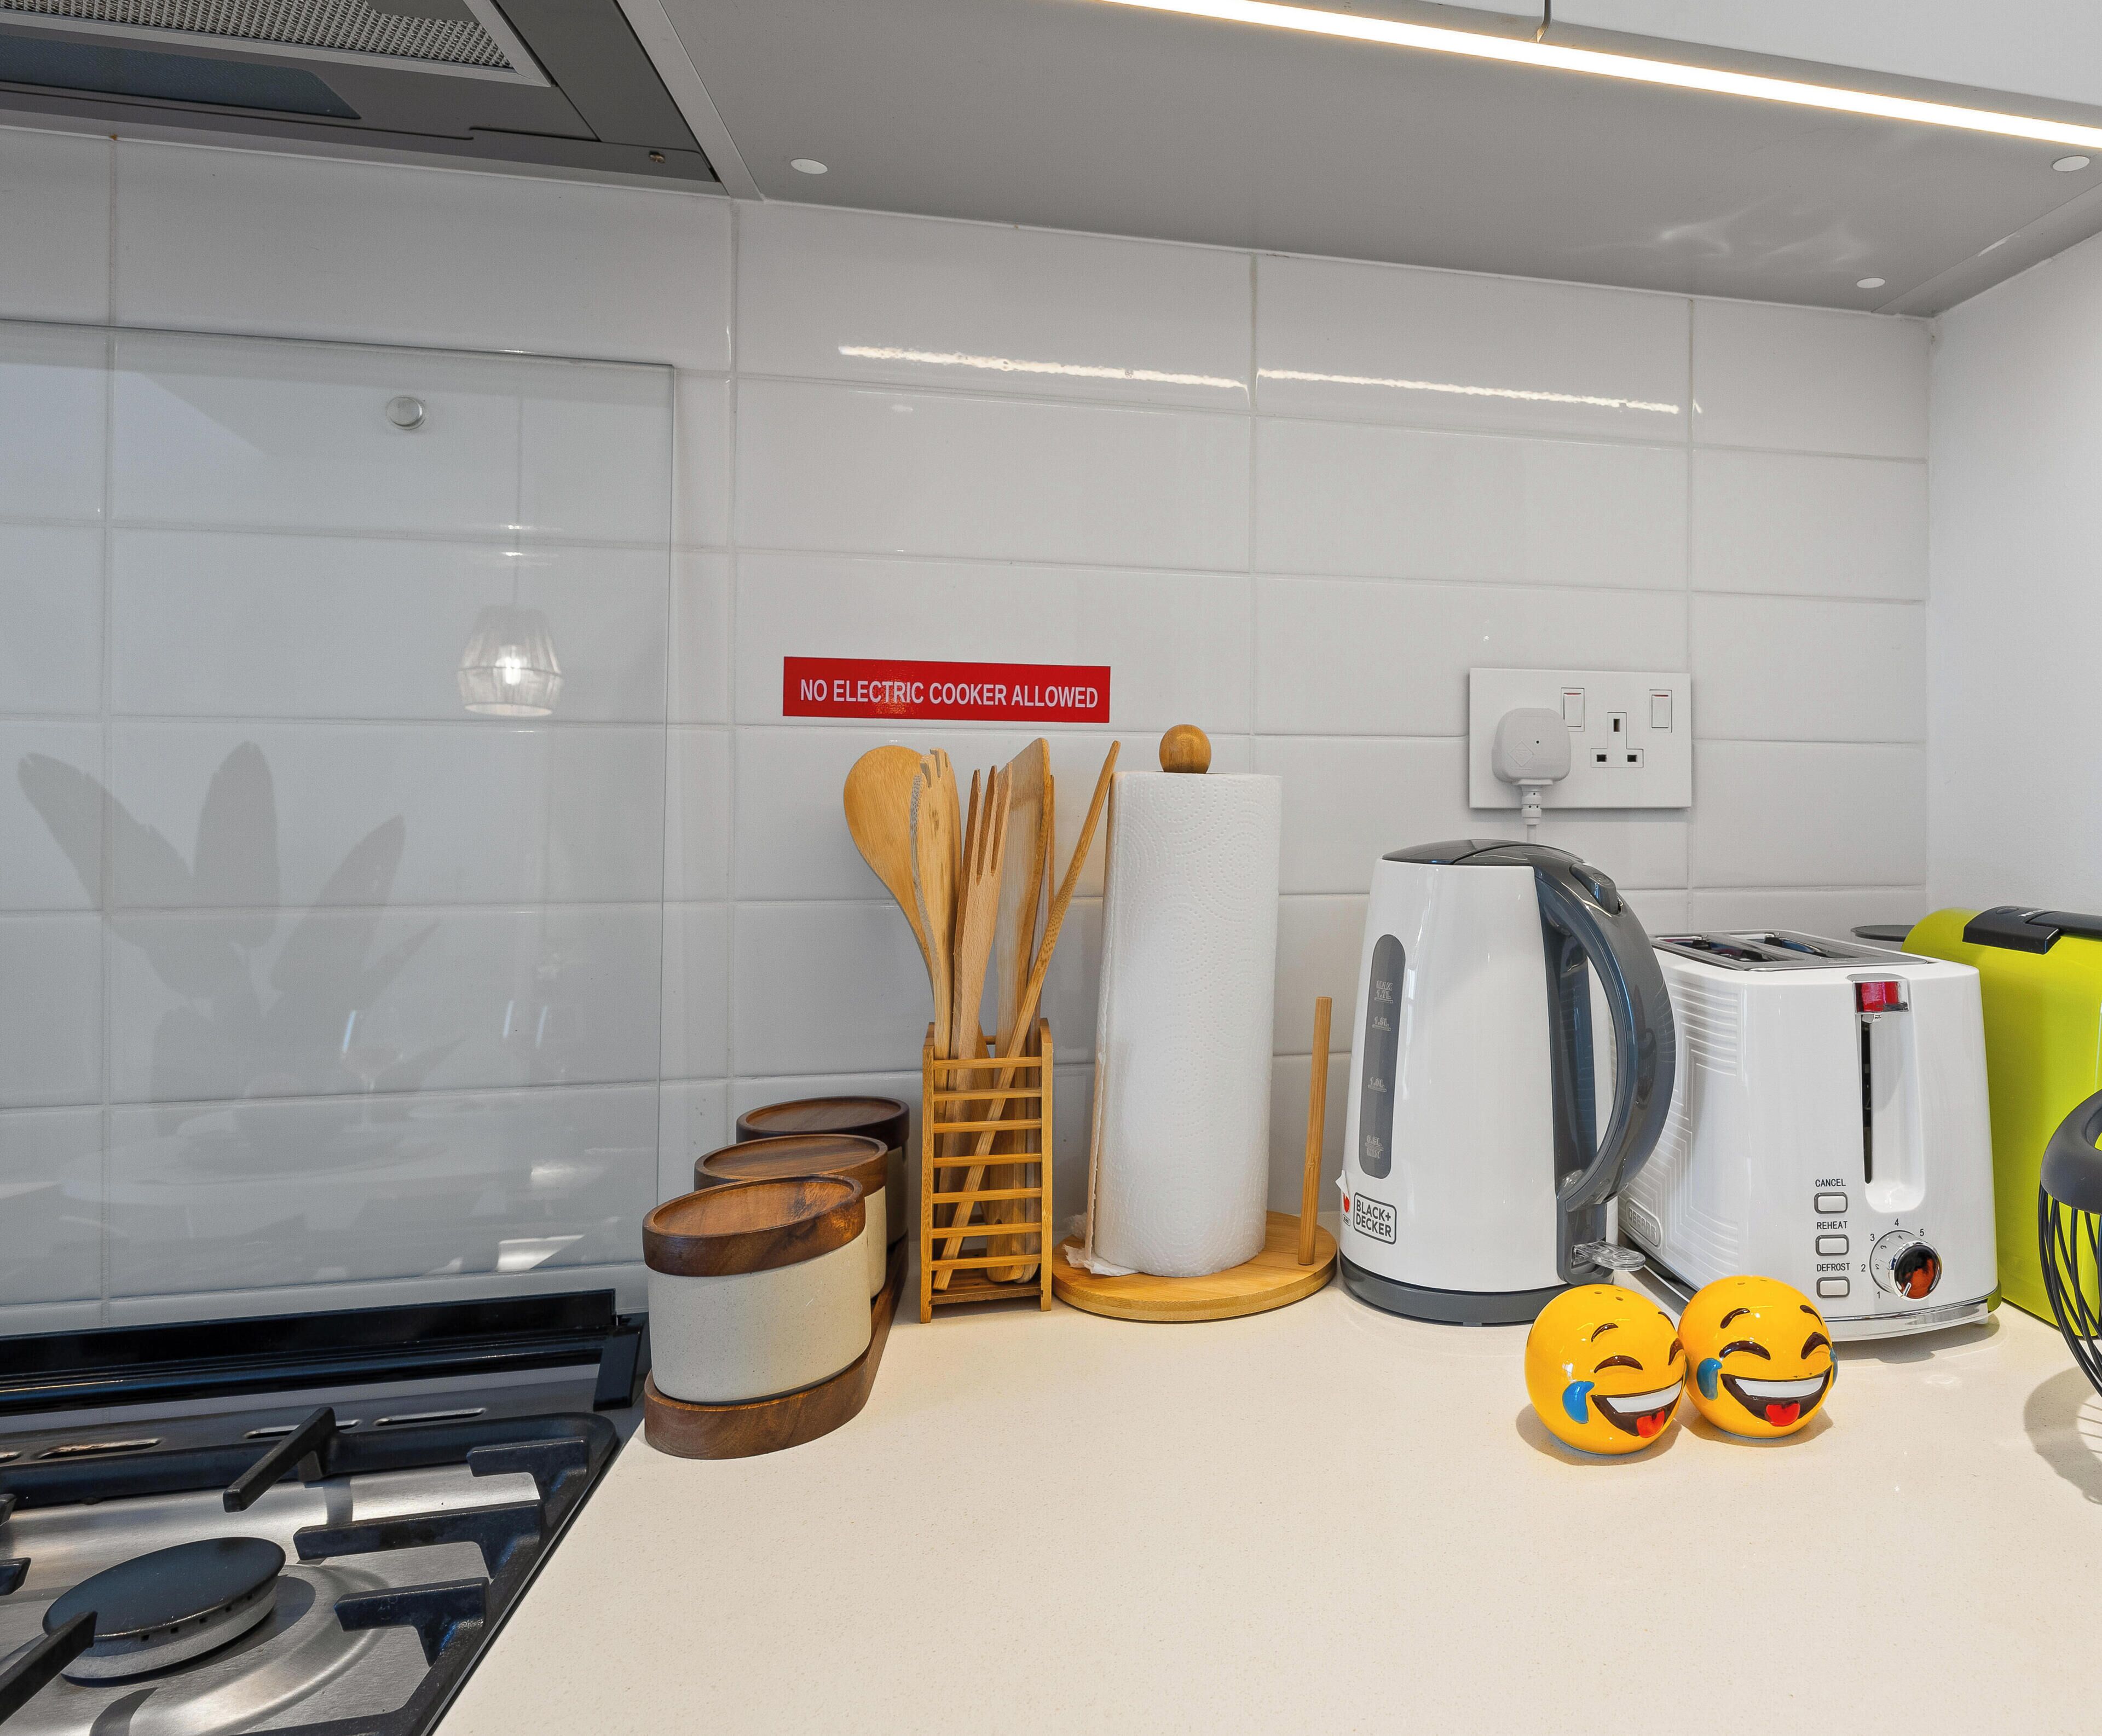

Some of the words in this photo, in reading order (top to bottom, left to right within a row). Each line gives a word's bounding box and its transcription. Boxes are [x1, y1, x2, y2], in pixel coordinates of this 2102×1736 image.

[800, 679, 827, 701] NO
[833, 680, 924, 704] ELECTRIC
[929, 682, 1007, 705] COOKER
[1011, 685, 1098, 708] ALLOWED
[1815, 1179, 1846, 1187] CANCEL
[1356, 1198, 1391, 1222] BLACK+
[1356, 1212, 1391, 1238] DECKER
[1817, 1221, 1848, 1230] REHEAT
[1894, 1218, 1899, 1226] 4
[1870, 1233, 1875, 1242] 3
[1920, 1229, 1925, 1237] 5
[1816, 1262, 1851, 1272] DEFROST
[1861, 1264, 1866, 1272] 2
